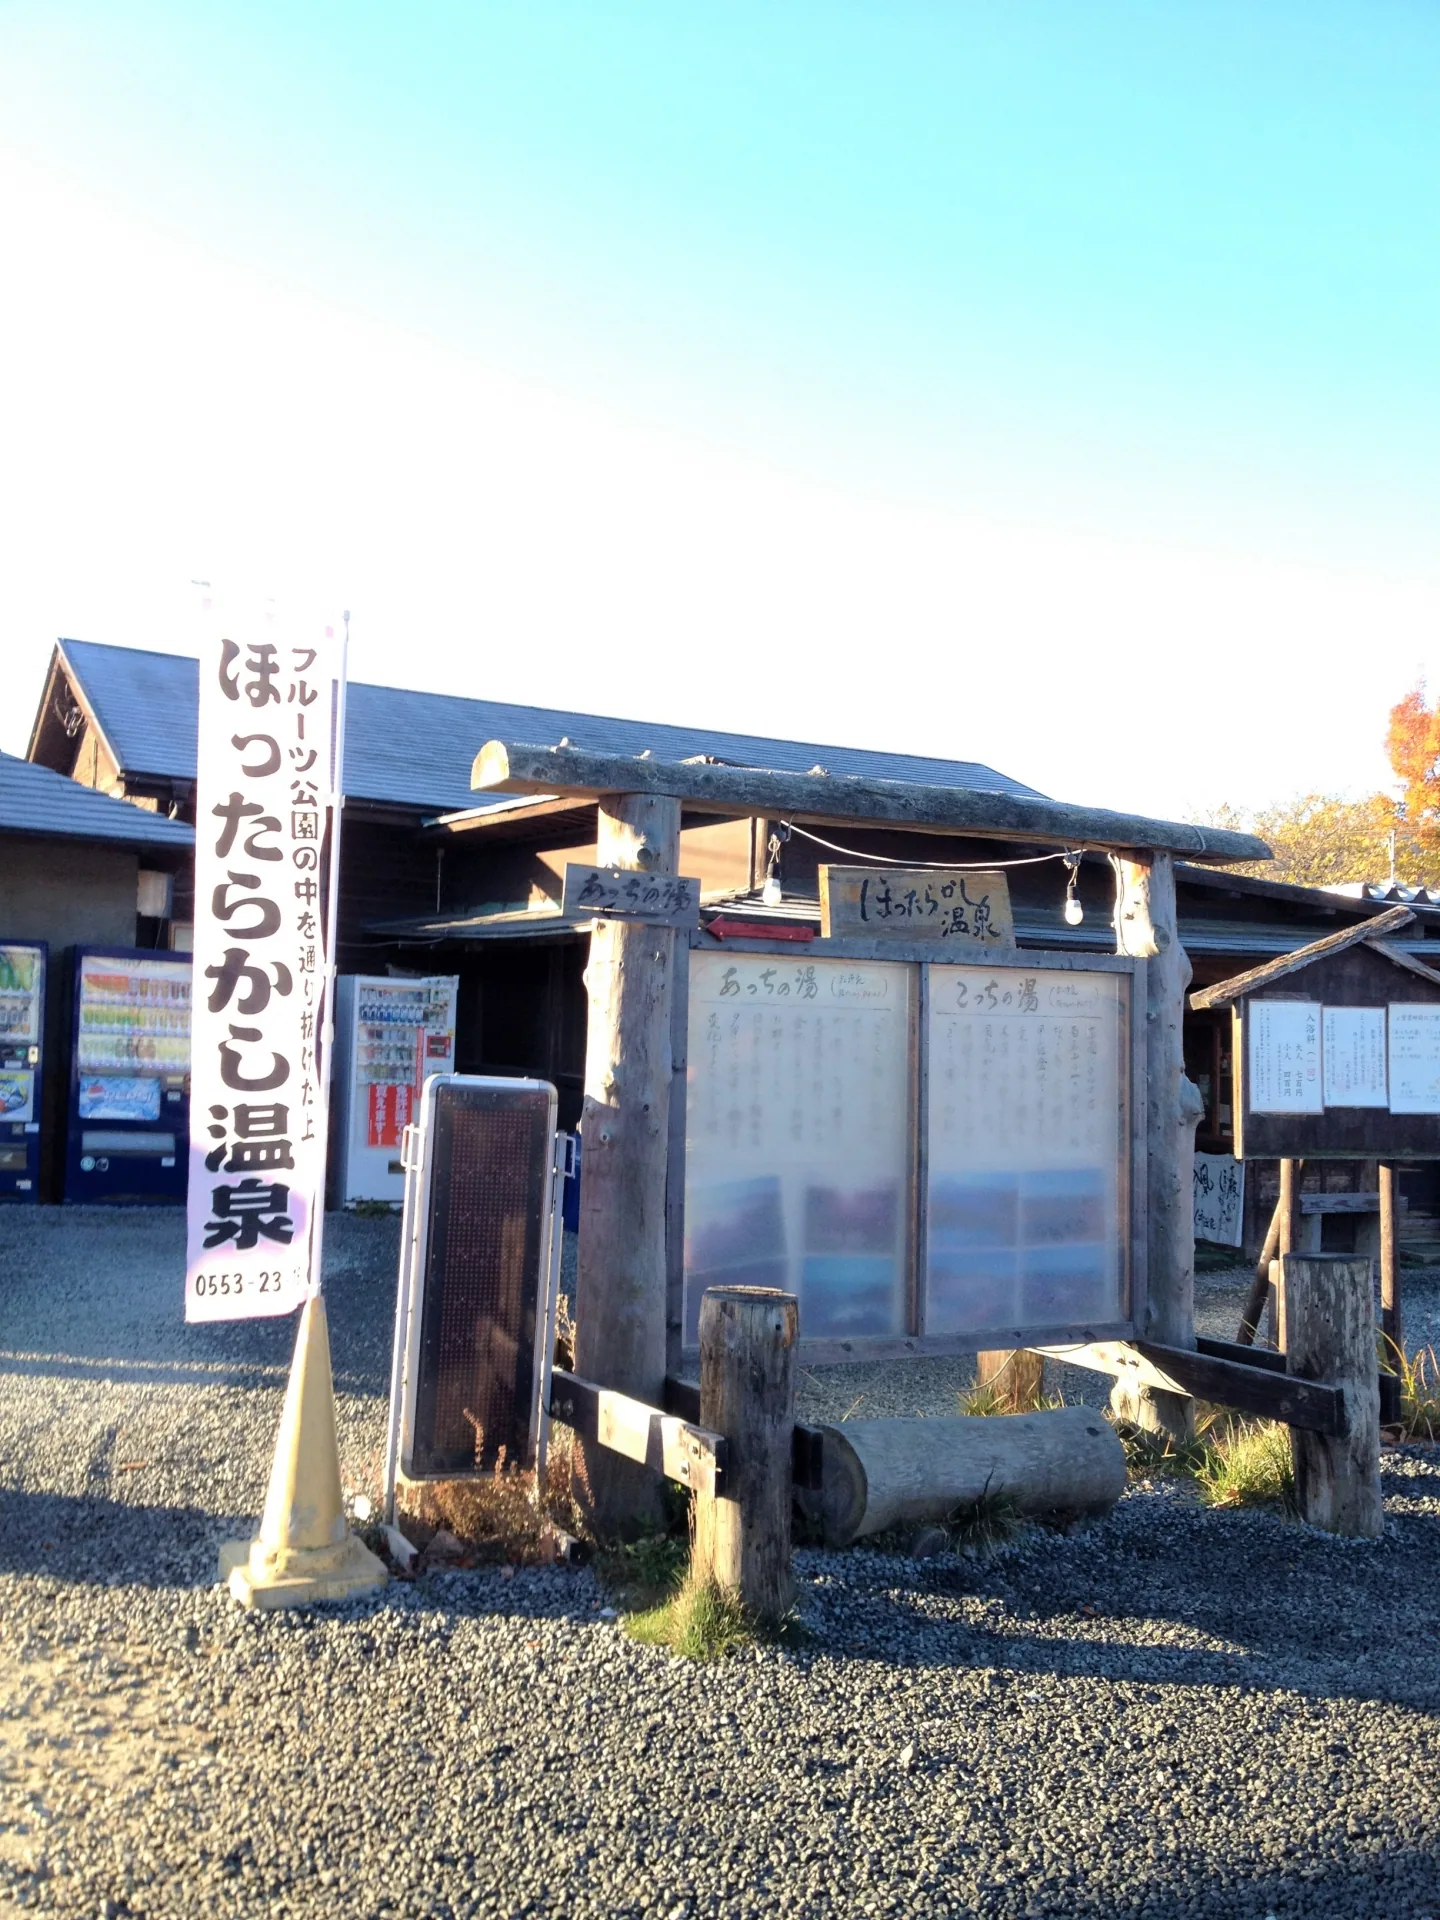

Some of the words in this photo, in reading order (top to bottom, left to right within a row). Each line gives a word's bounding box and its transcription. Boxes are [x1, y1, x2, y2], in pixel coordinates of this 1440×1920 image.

[577, 872, 692, 915] あっちの湯
[941, 895, 1001, 941] 温泉
[203, 639, 295, 1250] ほったらかし温泉
[719, 965, 819, 1000] あっちの湯
[956, 978, 1039, 1013] こっちの湯
